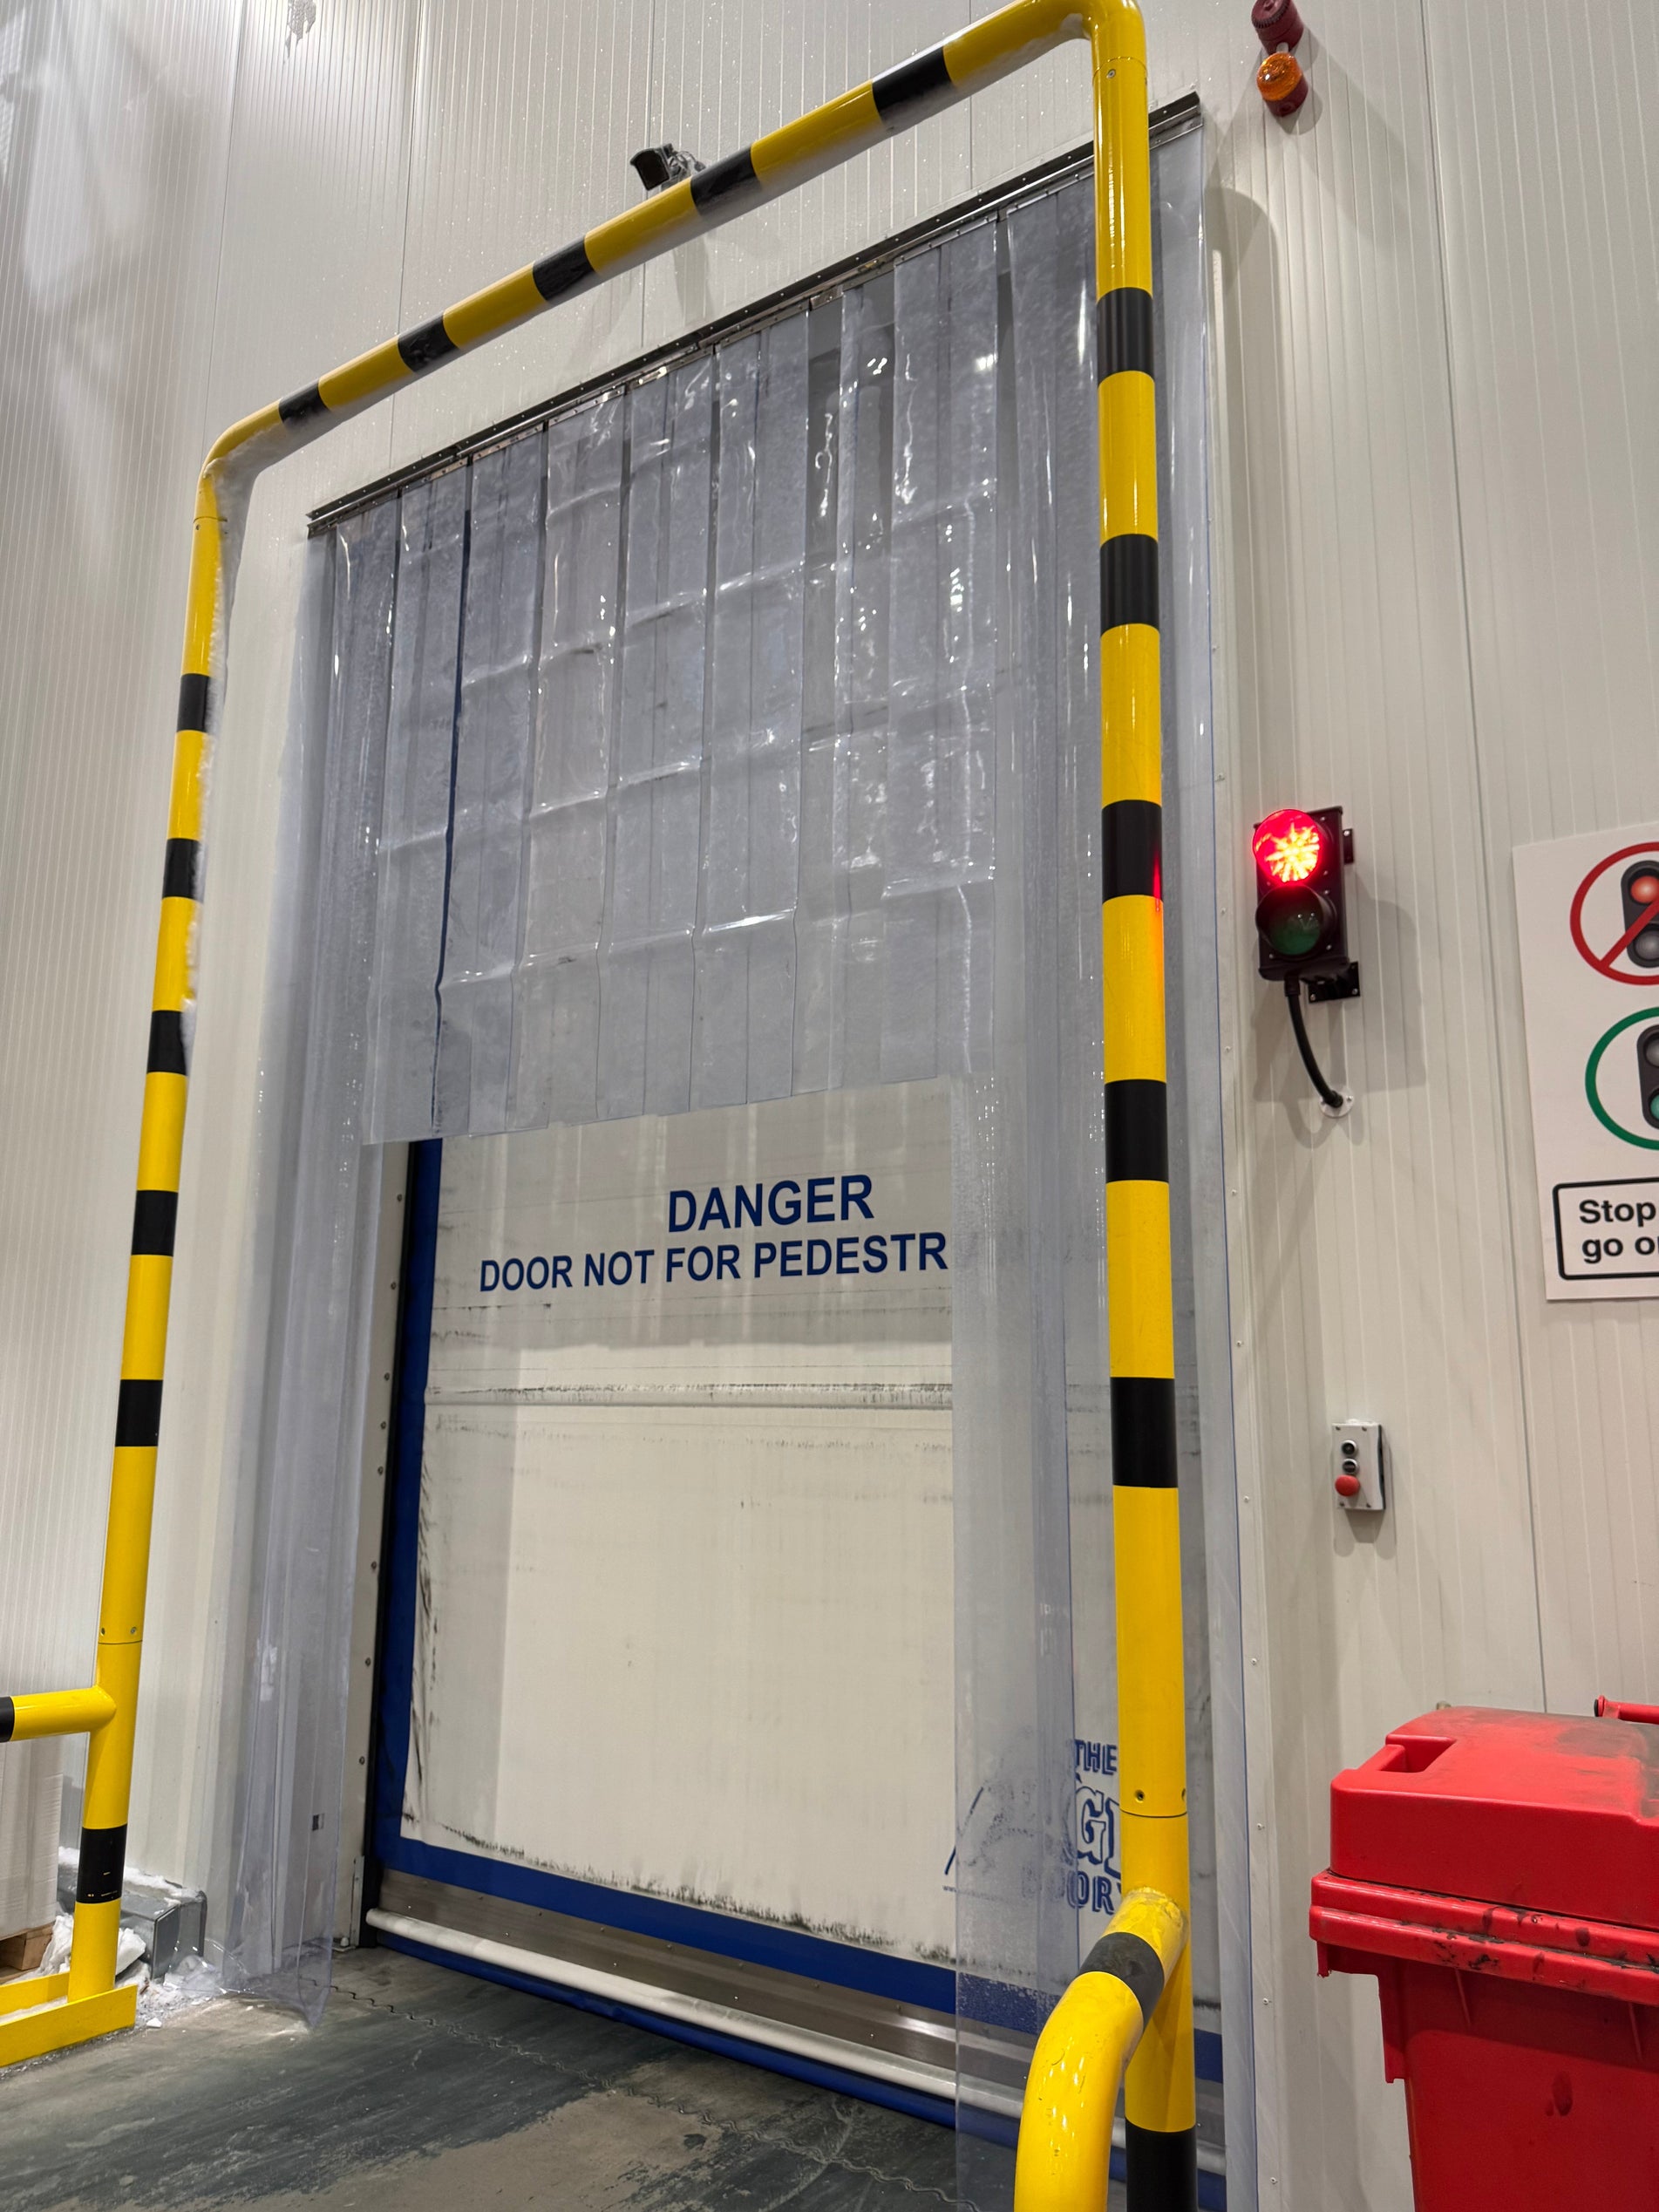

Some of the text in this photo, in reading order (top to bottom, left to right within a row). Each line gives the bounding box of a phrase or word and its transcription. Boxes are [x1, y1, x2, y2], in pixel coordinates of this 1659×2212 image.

[668, 1174, 874, 1233] DANGER
[1579, 1199, 1656, 1228] Stop
[479, 1255, 573, 1292] DOOR
[584, 1249, 656, 1288] NOT
[666, 1244, 741, 1283] FOR
[1581, 1235, 1659, 1264] go o
